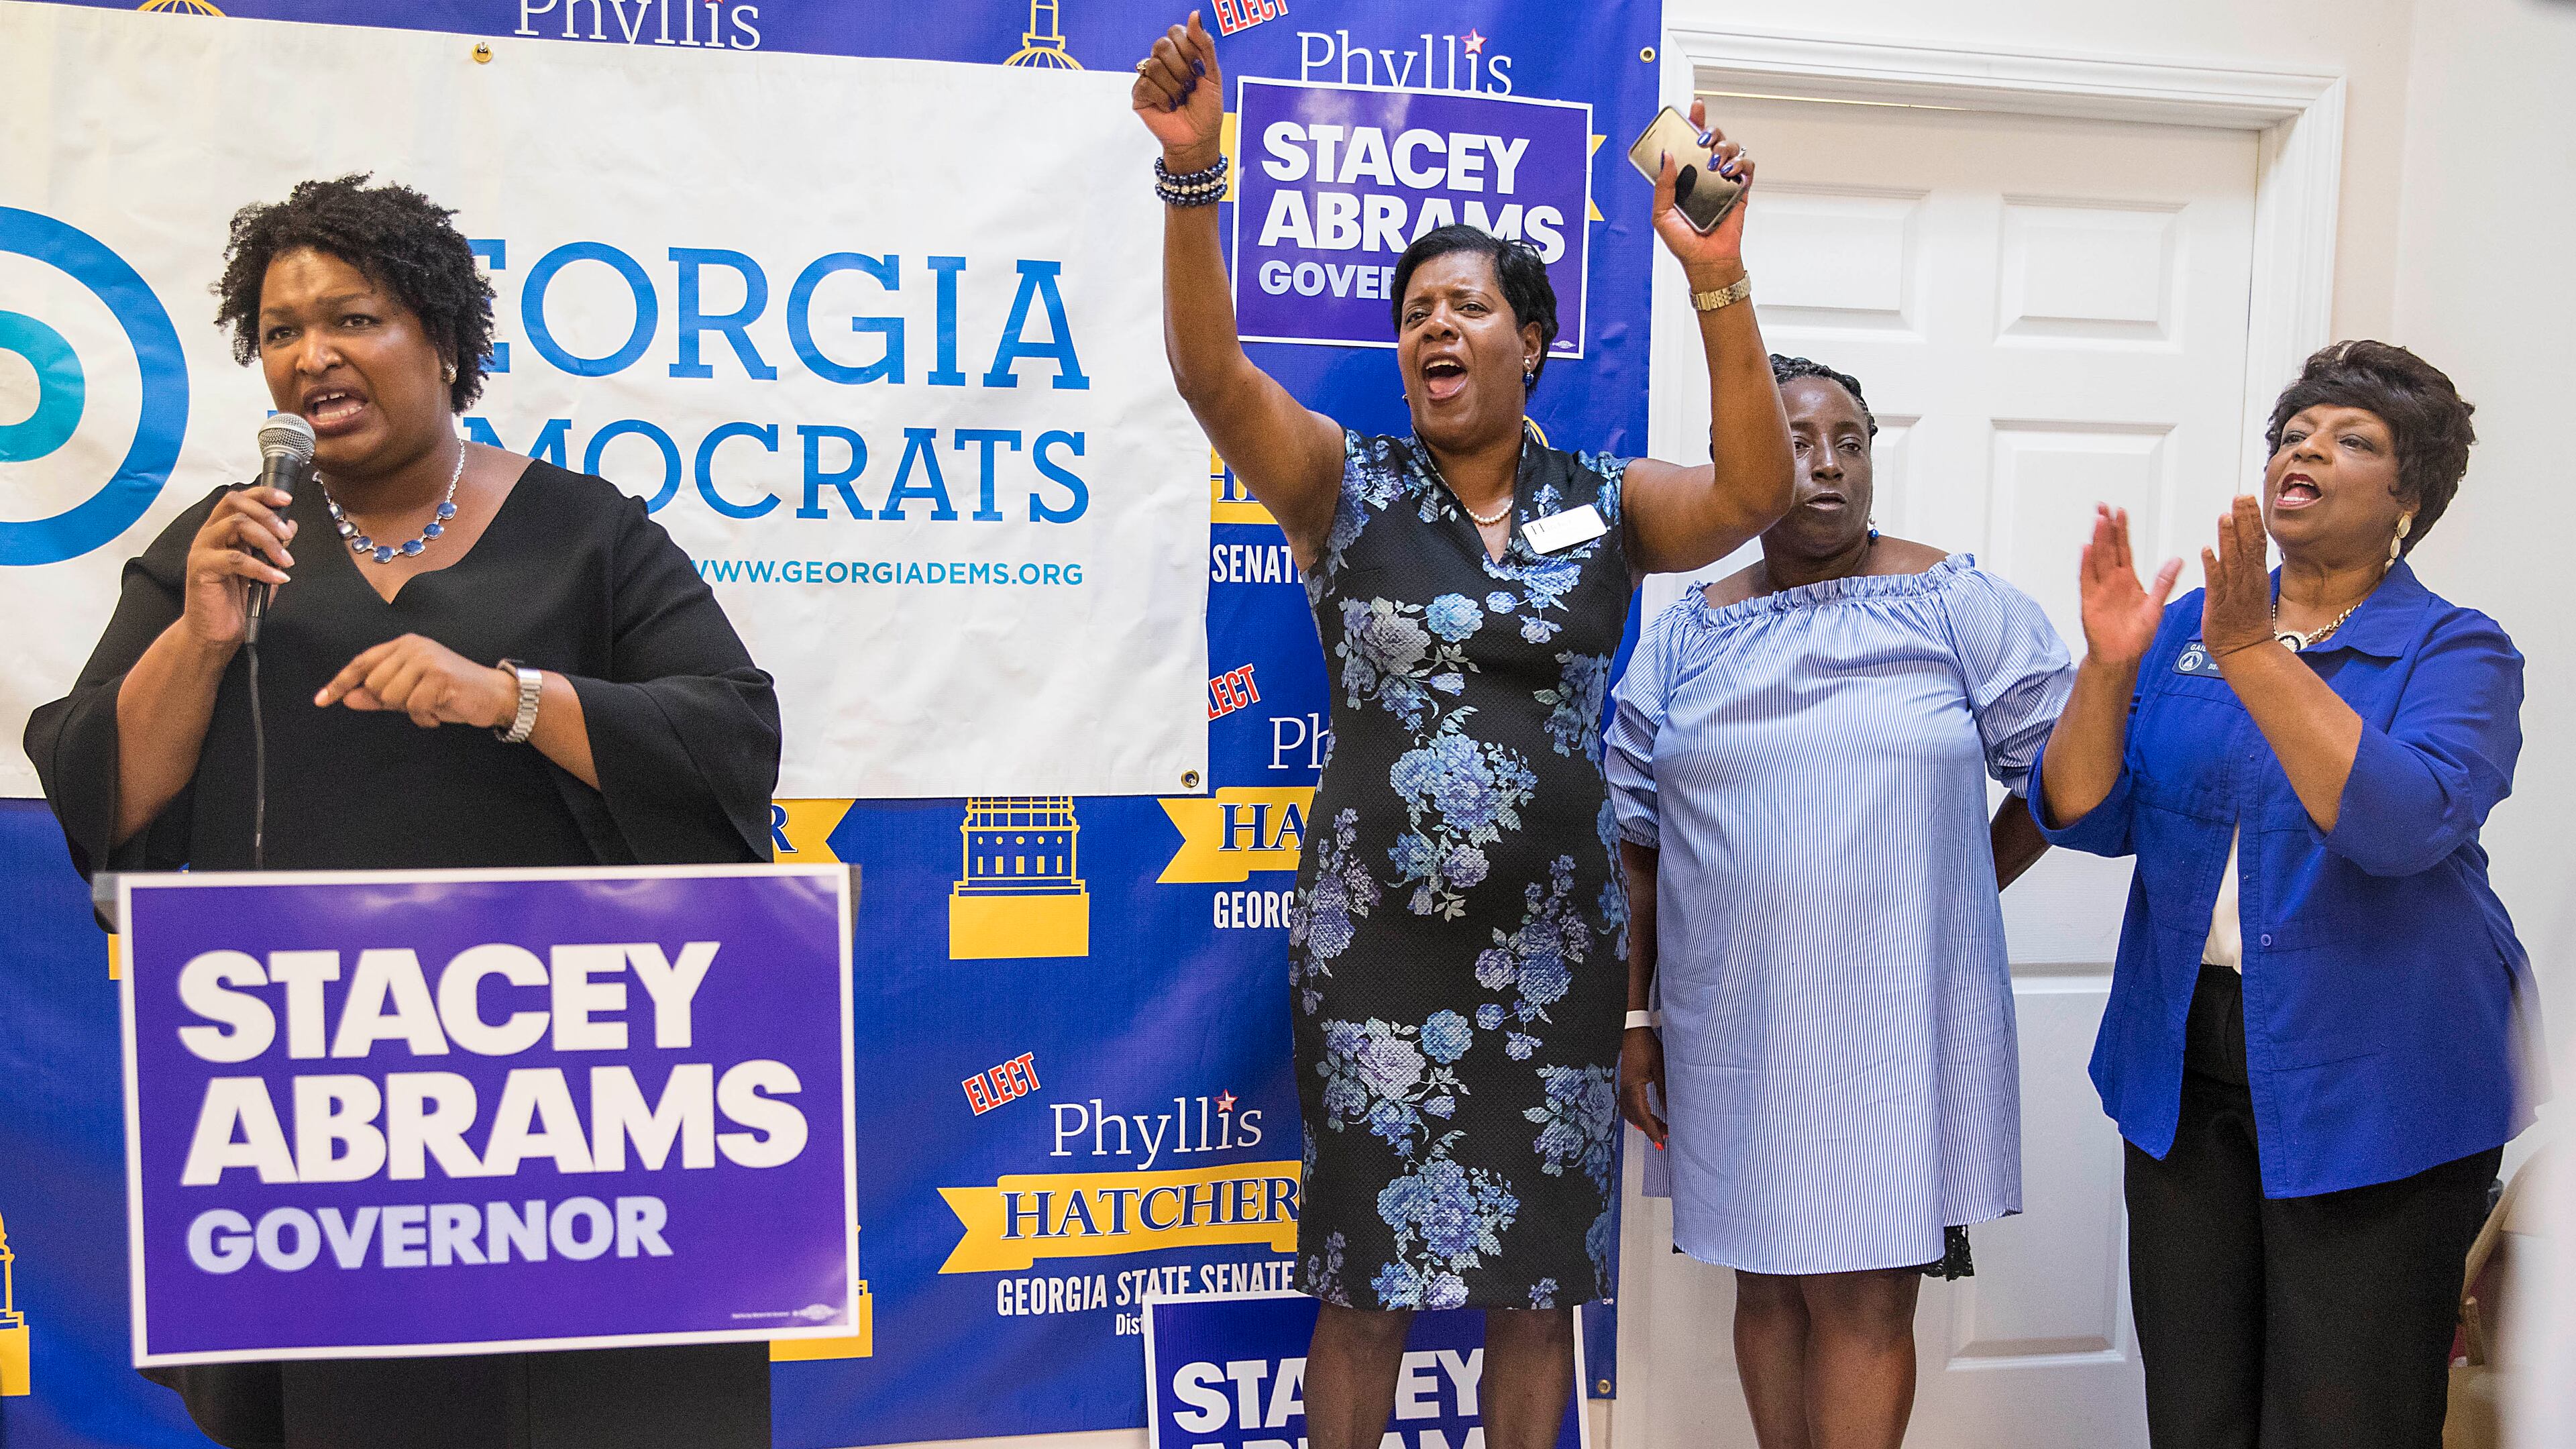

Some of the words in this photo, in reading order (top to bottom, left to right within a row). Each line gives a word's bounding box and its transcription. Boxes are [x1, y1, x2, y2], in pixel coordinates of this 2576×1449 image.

[1297, 30, 1513, 96] Phyllis
[1261, 121, 1530, 195] STACEY
[1212, 544, 1303, 584] SENAT
[177, 941, 721, 1064] STACEY
[961, 1051, 1041, 1116] ELECT
[181, 1059, 809, 1186] ABRAMS
[1050, 1095, 1263, 1170] Phyllis
[186, 1195, 674, 1275] GOVERNOR
[1000, 1177, 1300, 1240] HATCHER
[997, 1275, 1108, 1316] GEORGIA
[1116, 1265, 1192, 1306] STATE
[1200, 1260, 1295, 1294] SENATE
[1173, 1348, 1485, 1434] STAEY
